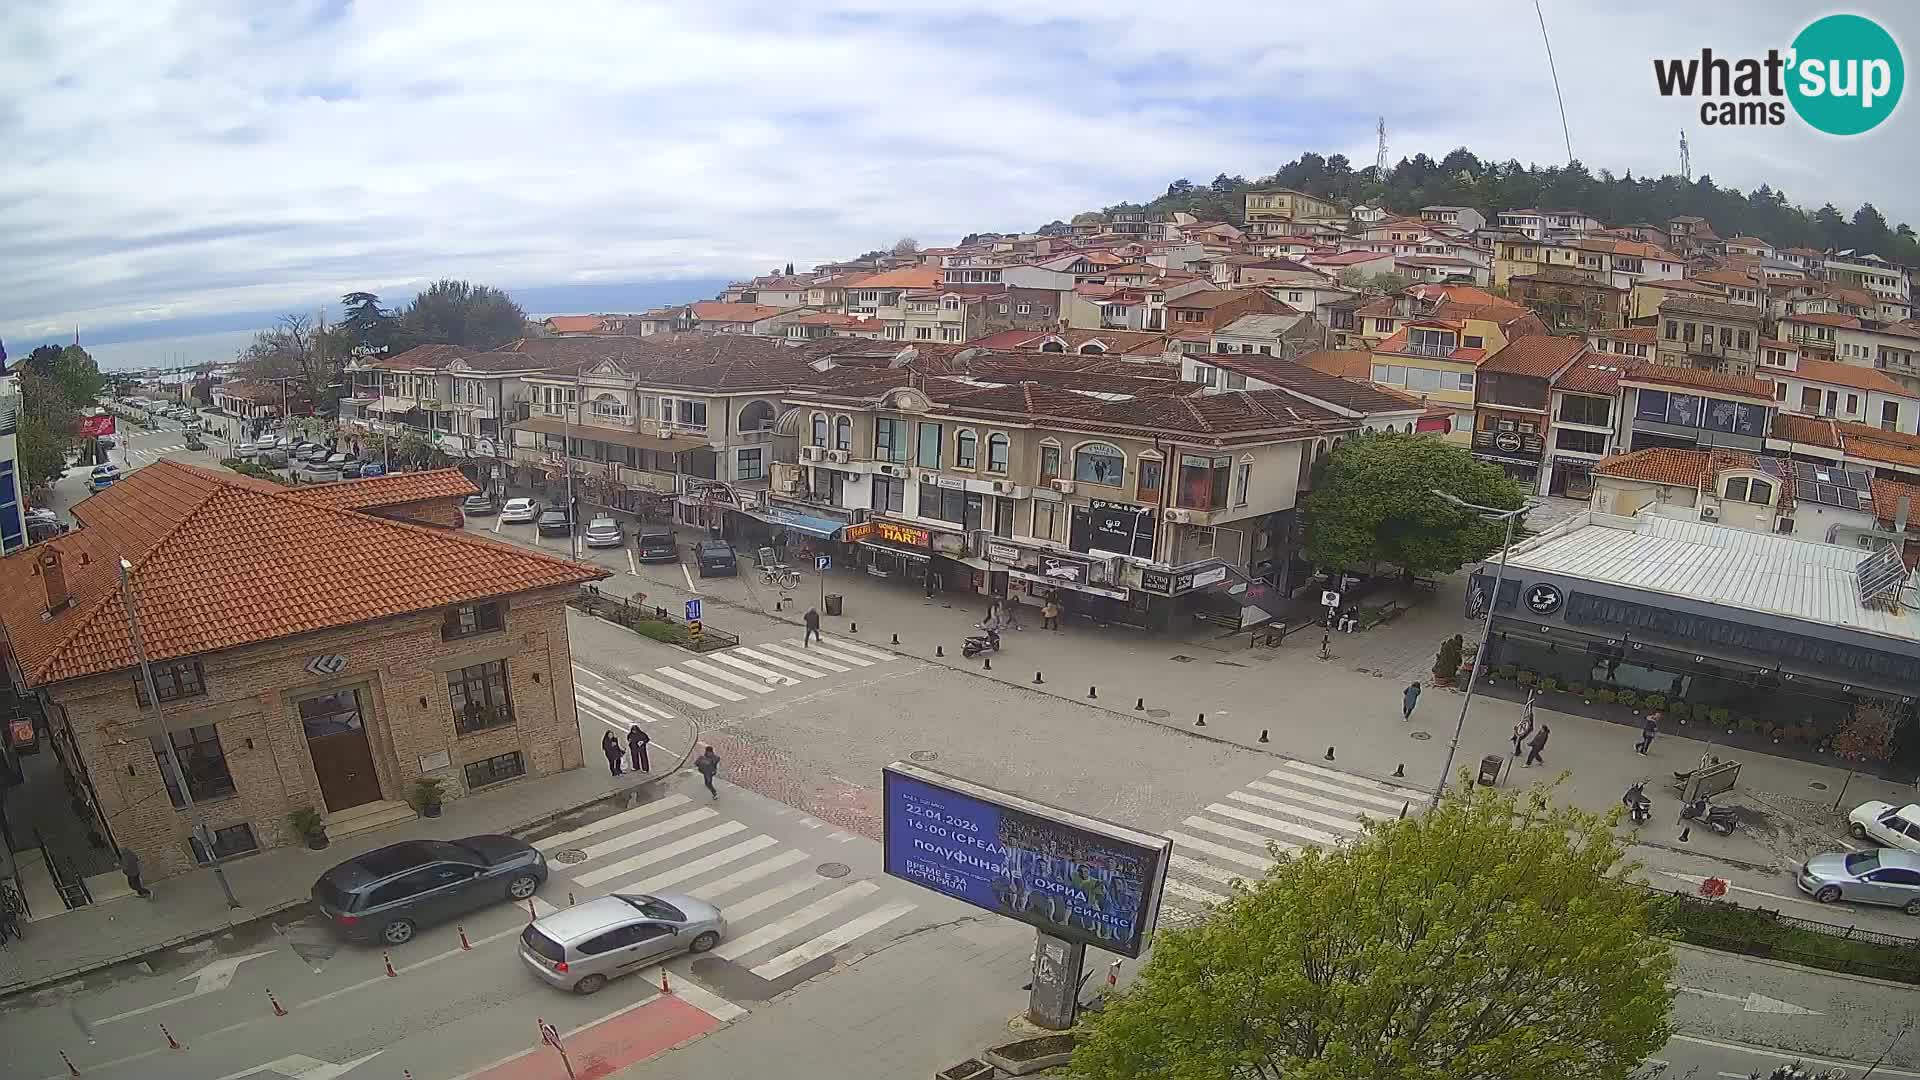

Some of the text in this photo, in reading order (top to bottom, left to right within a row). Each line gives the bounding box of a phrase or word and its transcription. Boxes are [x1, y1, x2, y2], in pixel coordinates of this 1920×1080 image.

[819, 558, 827, 569] P
[905, 803, 979, 832] 22.04.2026
[906, 818, 947, 837] 16:00
[906, 859, 941, 878] ВРЕМЕ
[943, 872, 951, 880] Е
[953, 875, 968, 887] ЗА
[1073, 906, 1129, 927] СИЛЕКС
